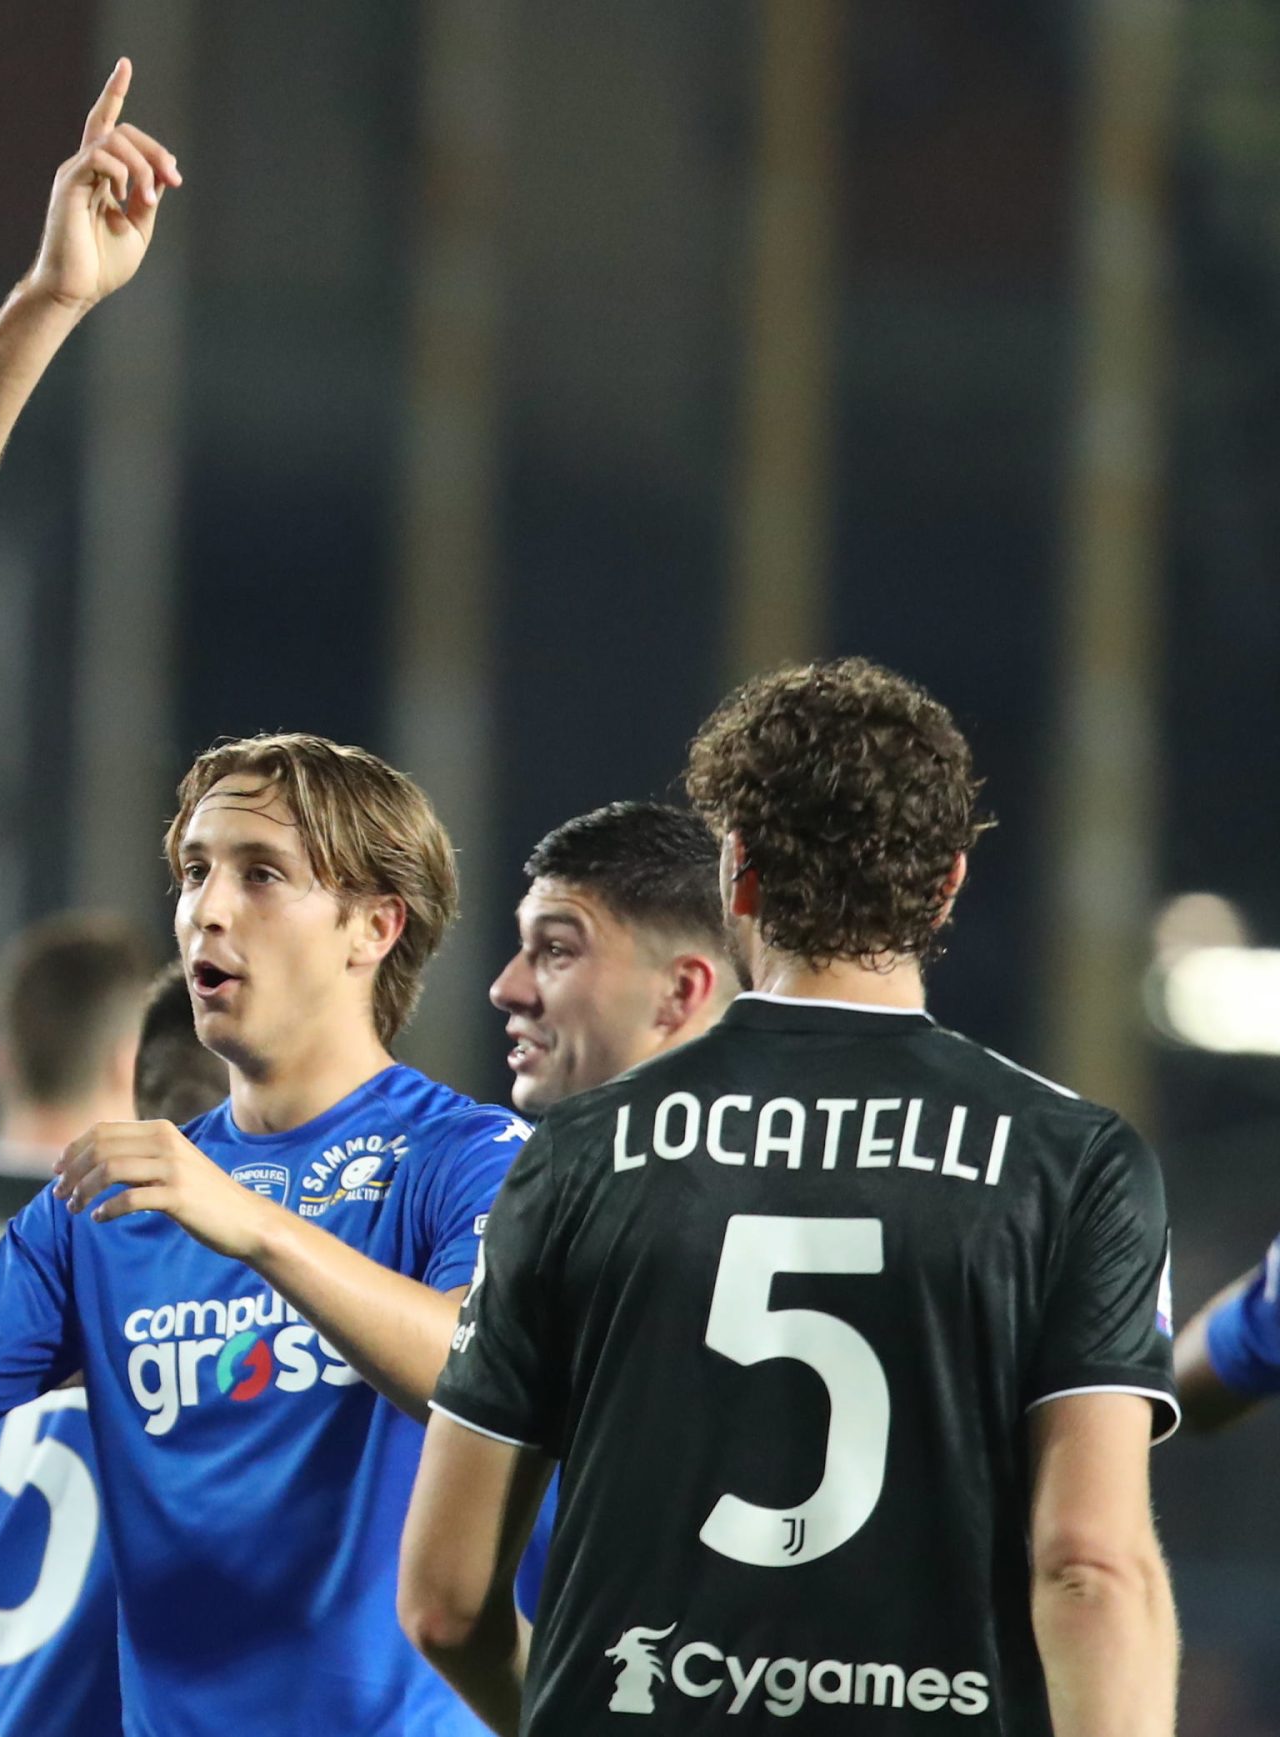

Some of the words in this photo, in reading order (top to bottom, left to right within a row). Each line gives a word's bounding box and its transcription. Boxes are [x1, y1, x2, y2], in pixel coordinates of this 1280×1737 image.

[613, 1091, 1012, 1186] LOCATELLI
[699, 1214, 891, 1567] 5
[670, 1641, 990, 1717] Cygames
